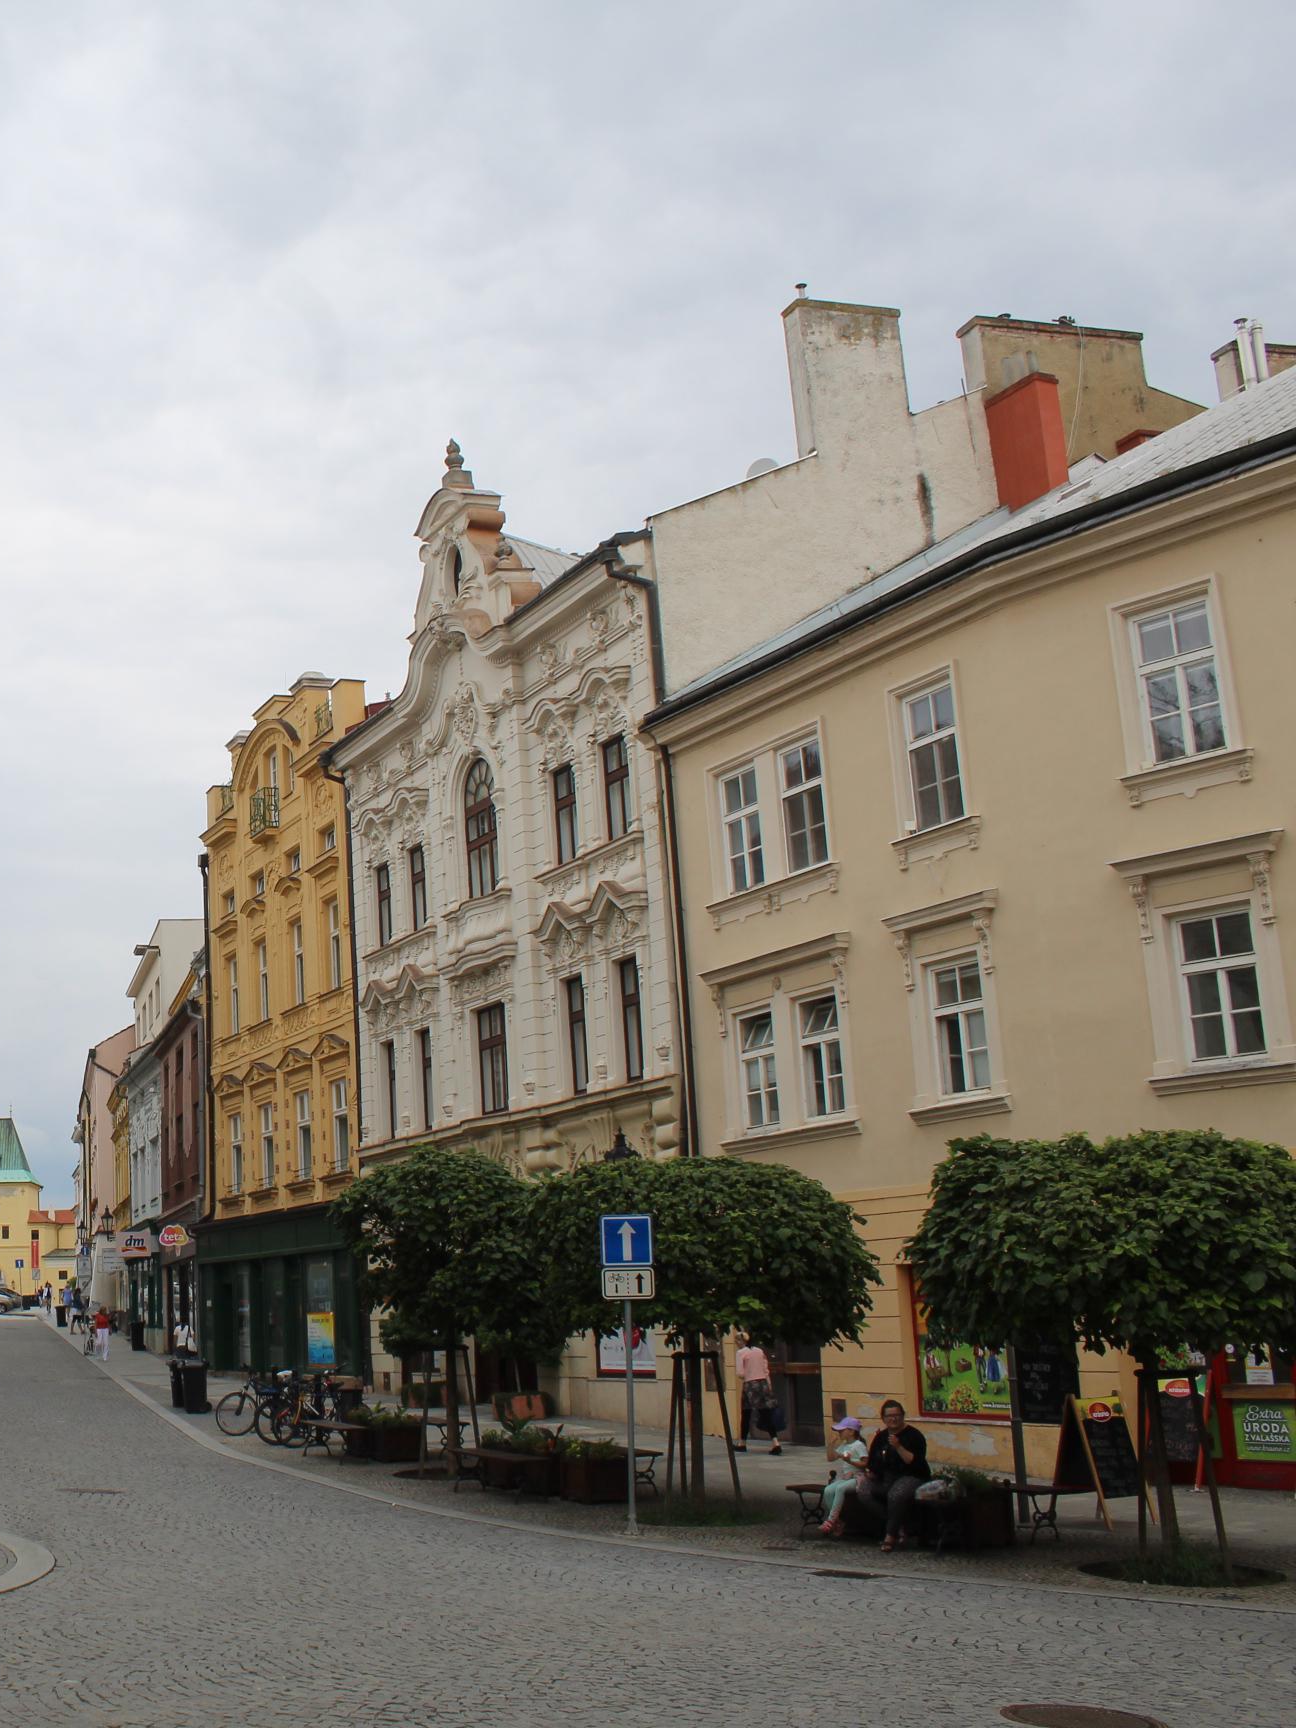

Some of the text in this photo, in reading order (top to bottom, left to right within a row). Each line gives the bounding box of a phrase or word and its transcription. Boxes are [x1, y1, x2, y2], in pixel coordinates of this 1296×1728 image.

[125, 1235, 145, 1247] dm
[164, 1232, 184, 1241] teta
[1246, 1405, 1282, 1421] Extra
[1243, 1420, 1290, 1433] ÚRODA
[1251, 1434, 1291, 1443] VALAŠSKA
